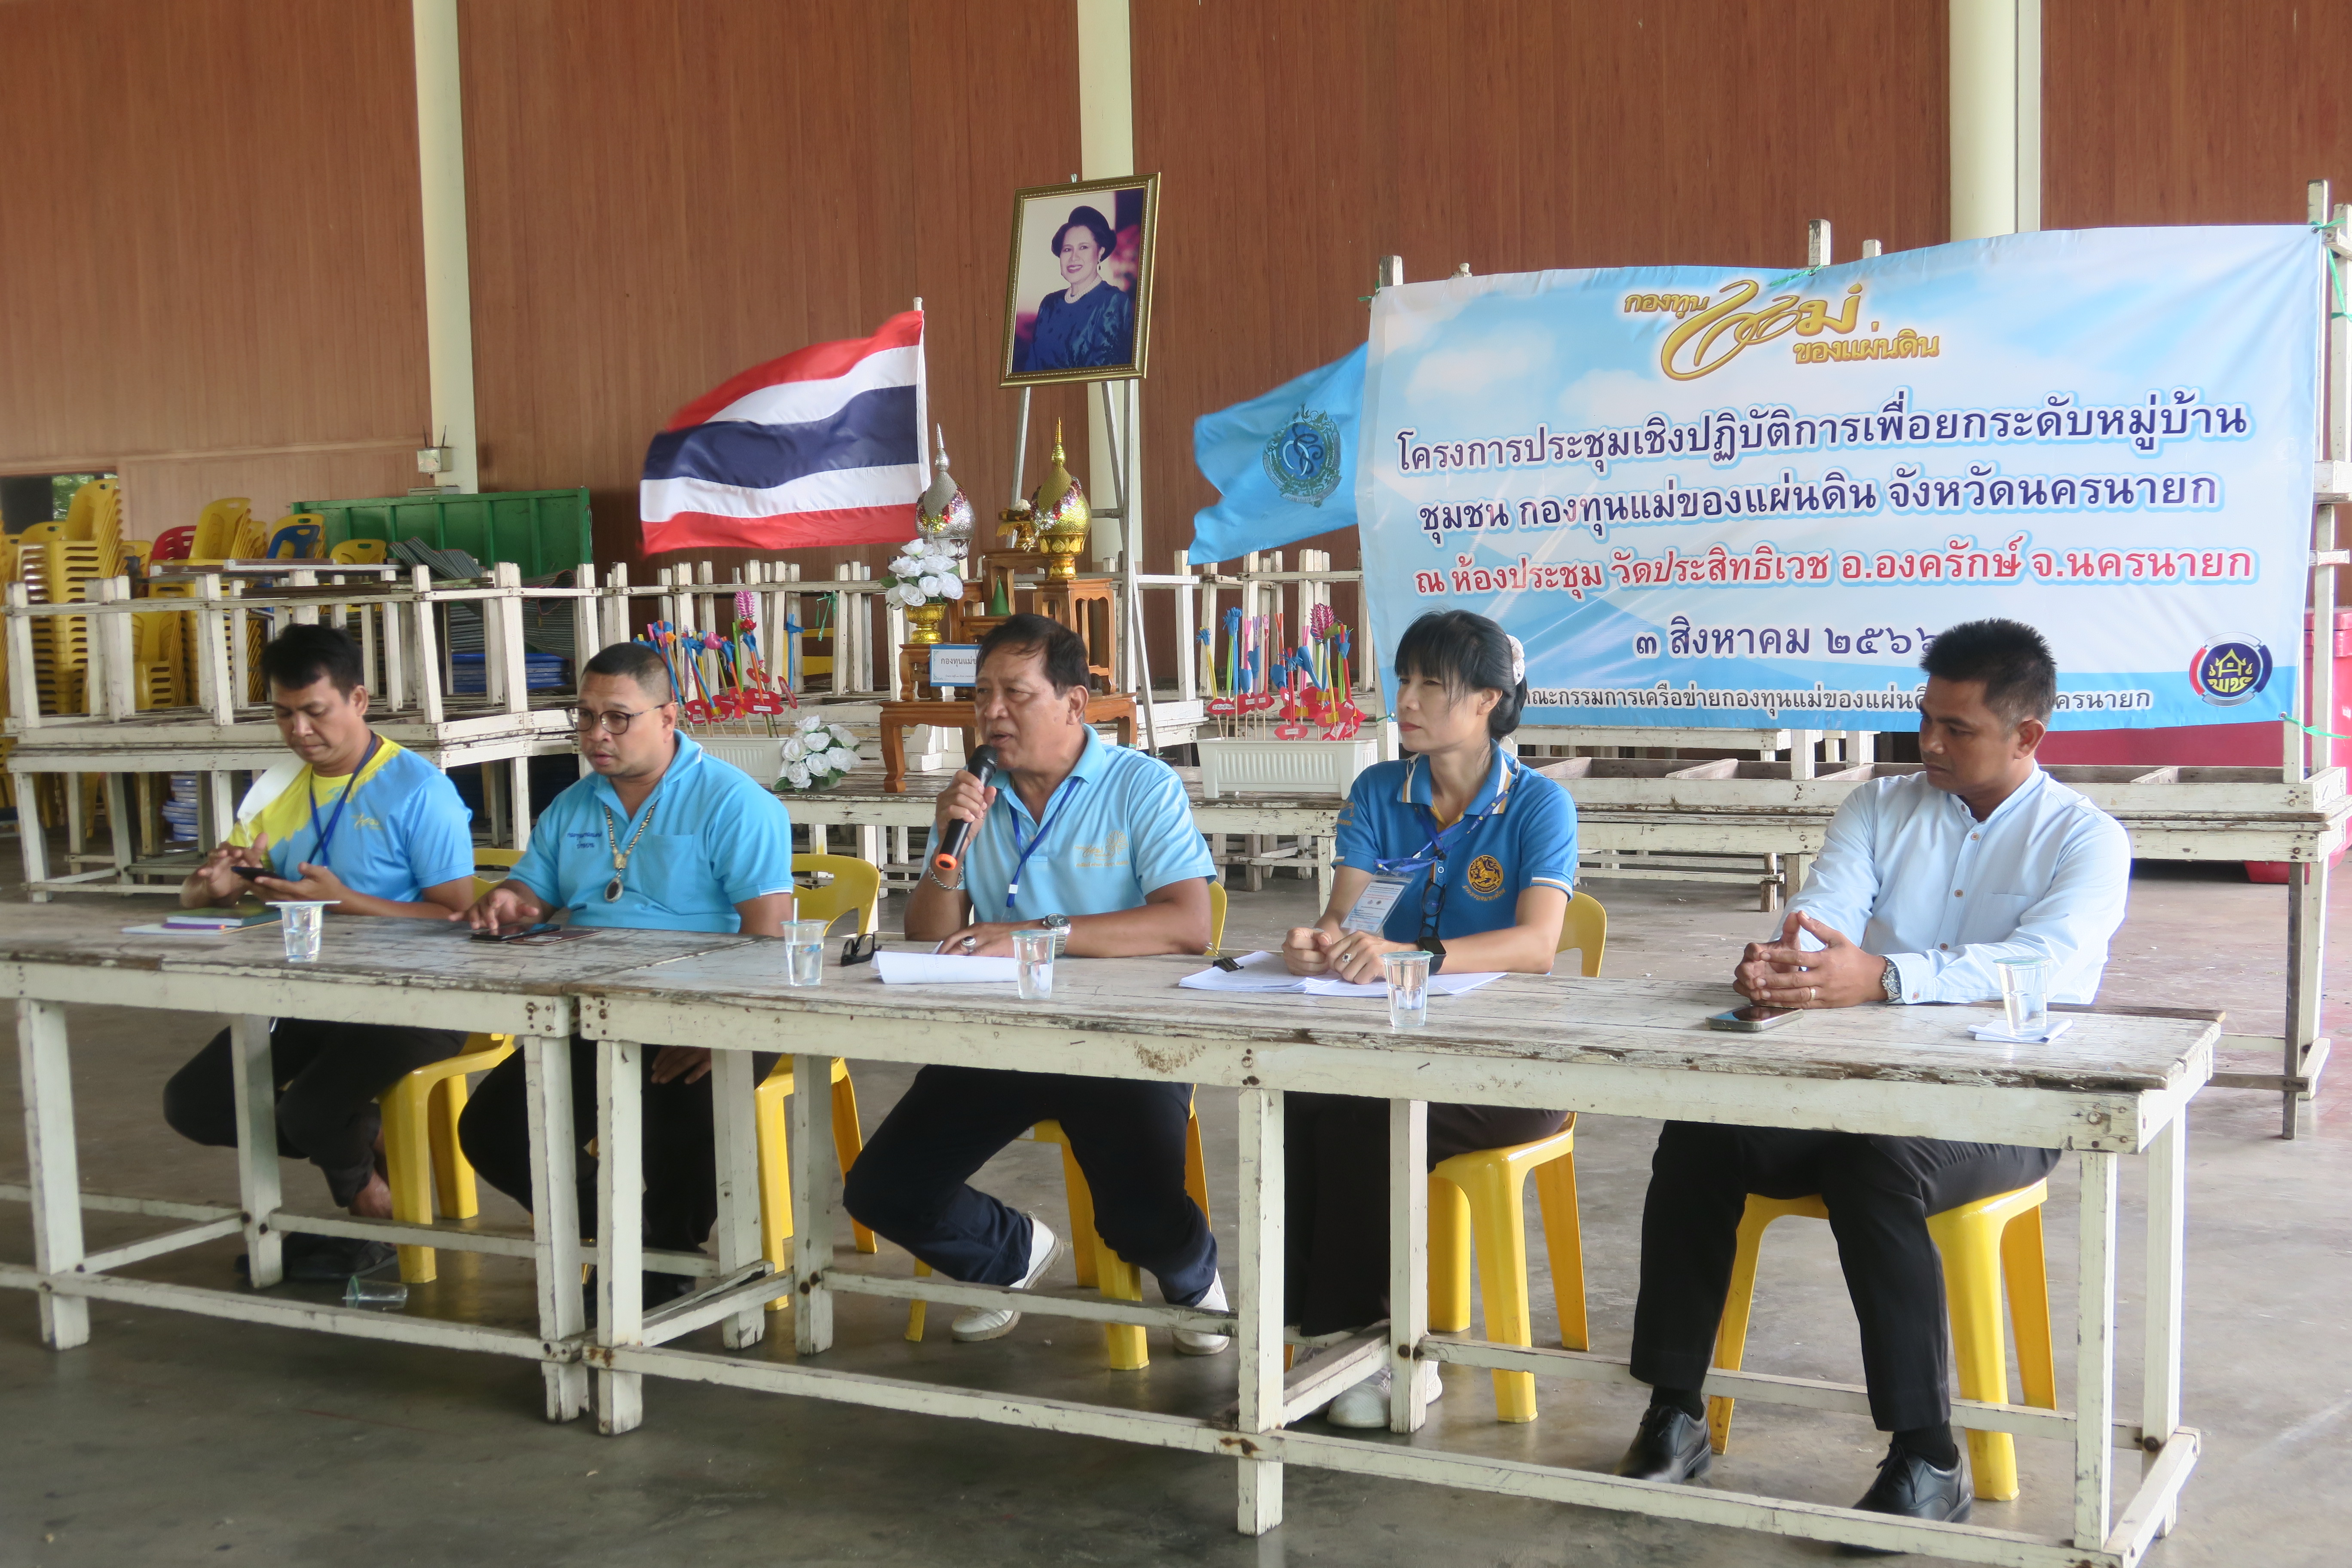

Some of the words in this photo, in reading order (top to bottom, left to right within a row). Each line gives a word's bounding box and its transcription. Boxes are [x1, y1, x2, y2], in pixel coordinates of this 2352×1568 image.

[1624, 293, 1709, 319] กองทุน
[1793, 321, 1940, 364] ของแผ่นดิน
[1398, 391, 2247, 472] โครงการประชุมเชิงปฏิบัติการเพื่อยกระดับหมู่บ้าน
[1420, 503, 1509, 545] ชุมชน
[1519, 472, 1876, 536] กองทุนแม่ของแผ่นดิน
[1889, 466, 2215, 508] จังหวัดนครนายก
[1416, 570, 1445, 593] ณ
[1452, 556, 1602, 600] ห้องประชุม
[1611, 546, 1829, 584] วัดประสิทธิเวช
[1843, 536, 2023, 579] อ.องครักษ์
[2033, 552, 2251, 577] จ.นครนายก
[1637, 636, 1657, 654] ๓
[1670, 616, 1810, 654] สิงหาคม
